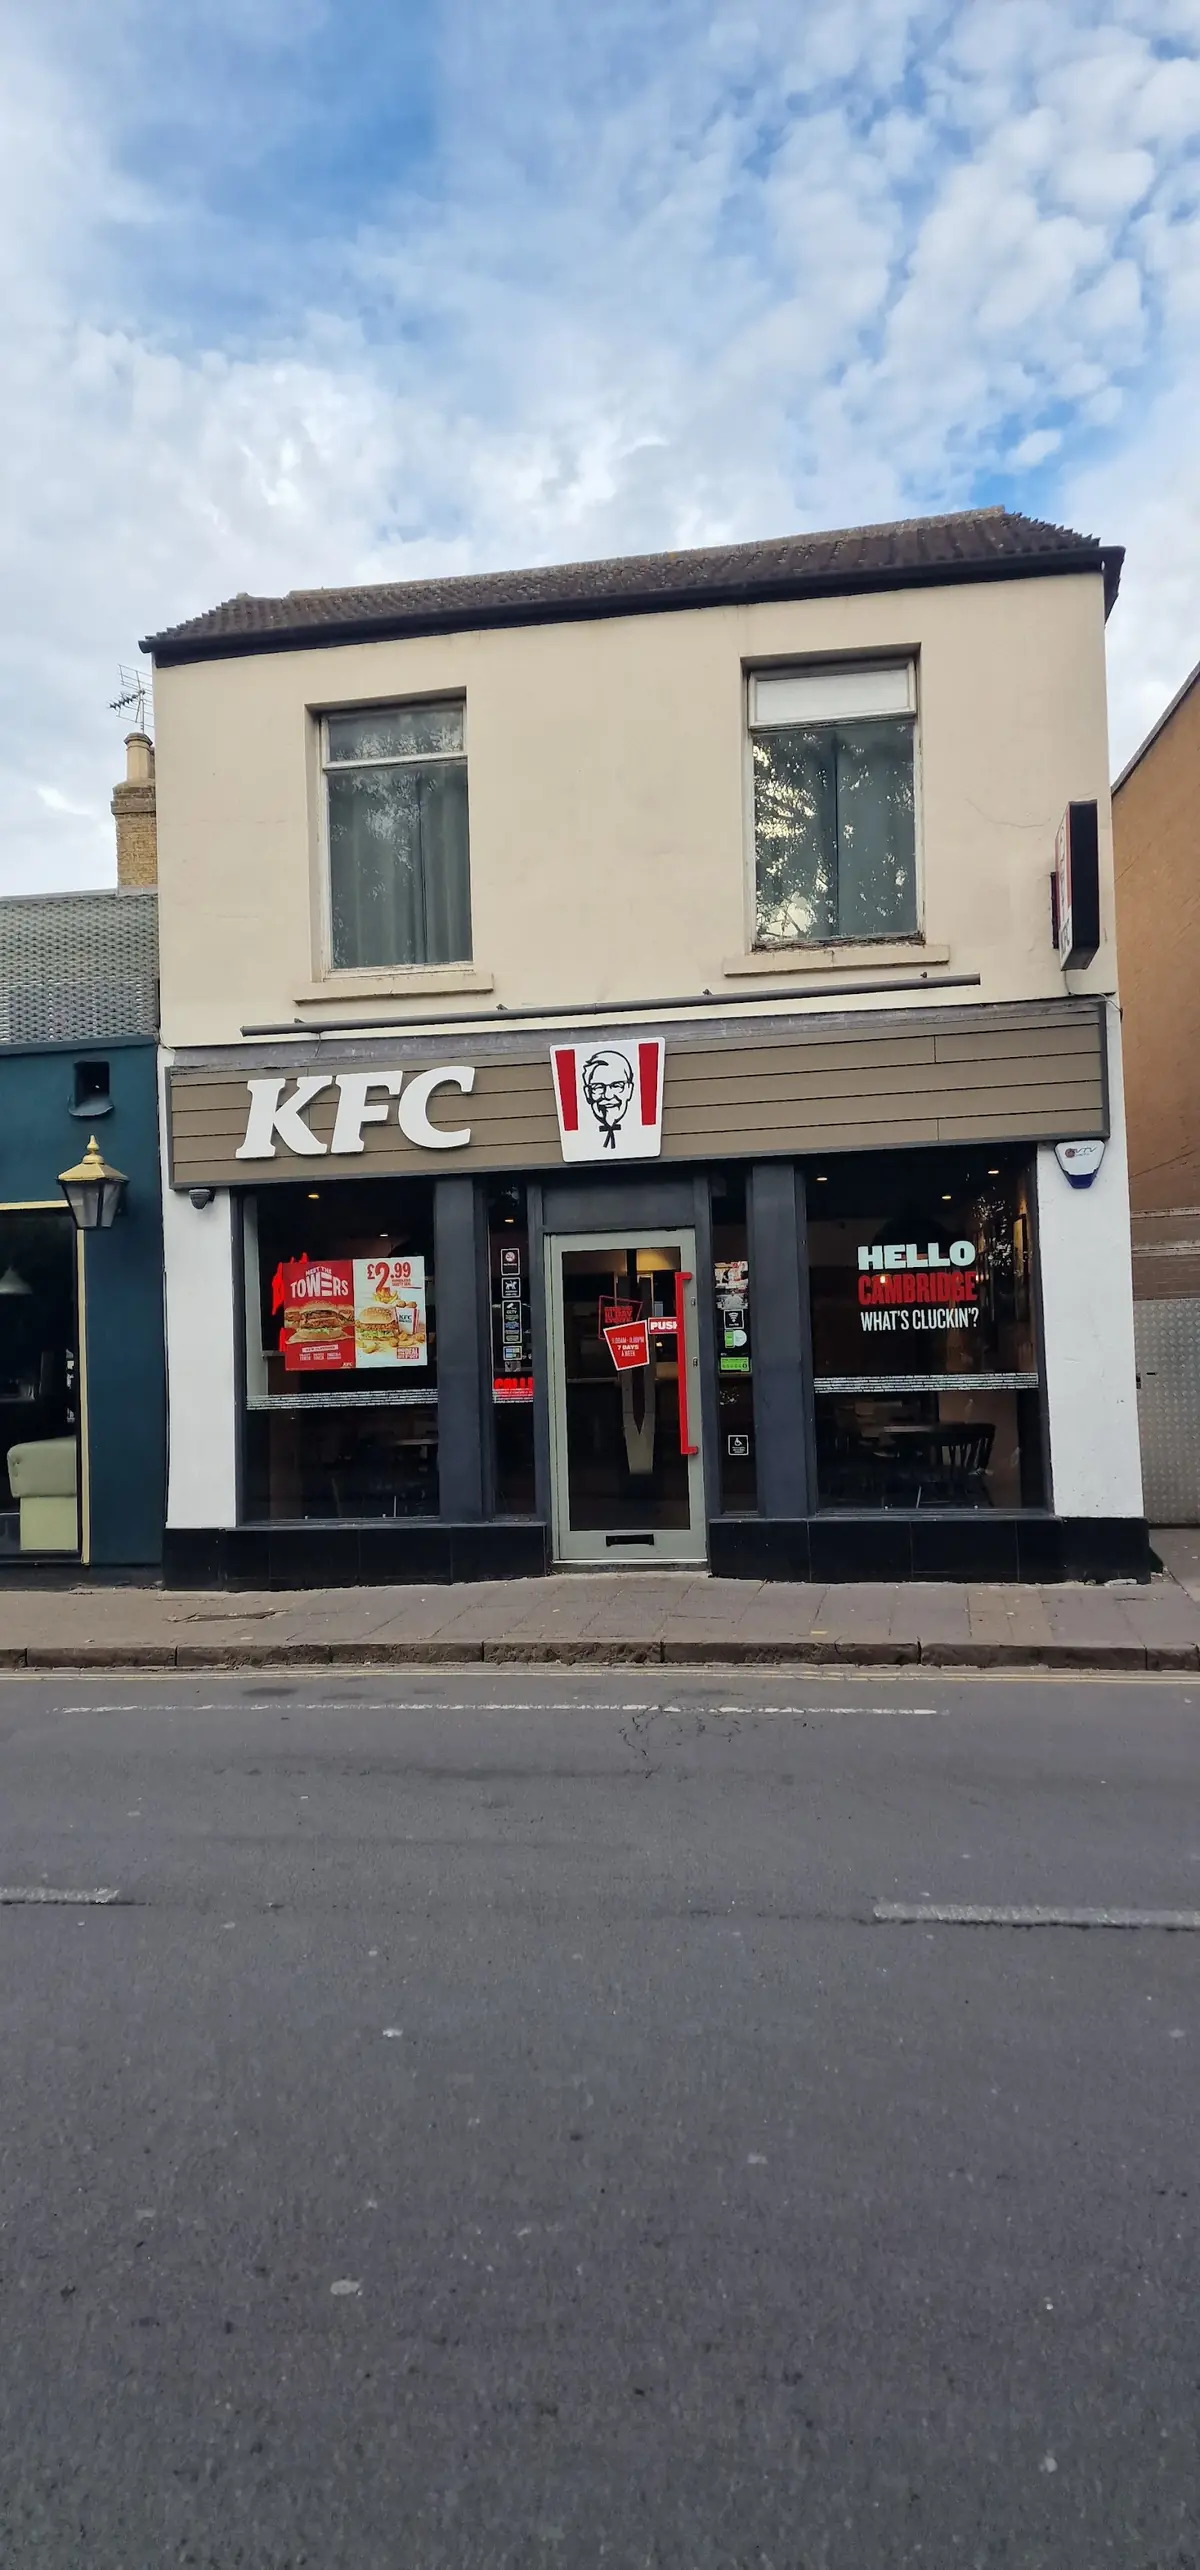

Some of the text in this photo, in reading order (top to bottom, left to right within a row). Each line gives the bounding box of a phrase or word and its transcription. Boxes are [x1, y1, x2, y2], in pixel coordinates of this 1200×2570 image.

[235, 1066, 475, 1159] KFC
[857, 1240, 976, 1270] HELLO
[290, 1272, 349, 1298] TOWERS
[305, 1266, 332, 1276] MEET THE
[367, 1262, 411, 1293] £2.99
[858, 1271, 978, 1305] CAMBRIDGE
[860, 1307, 979, 1331] WHAT'S CLUCKIN'?
